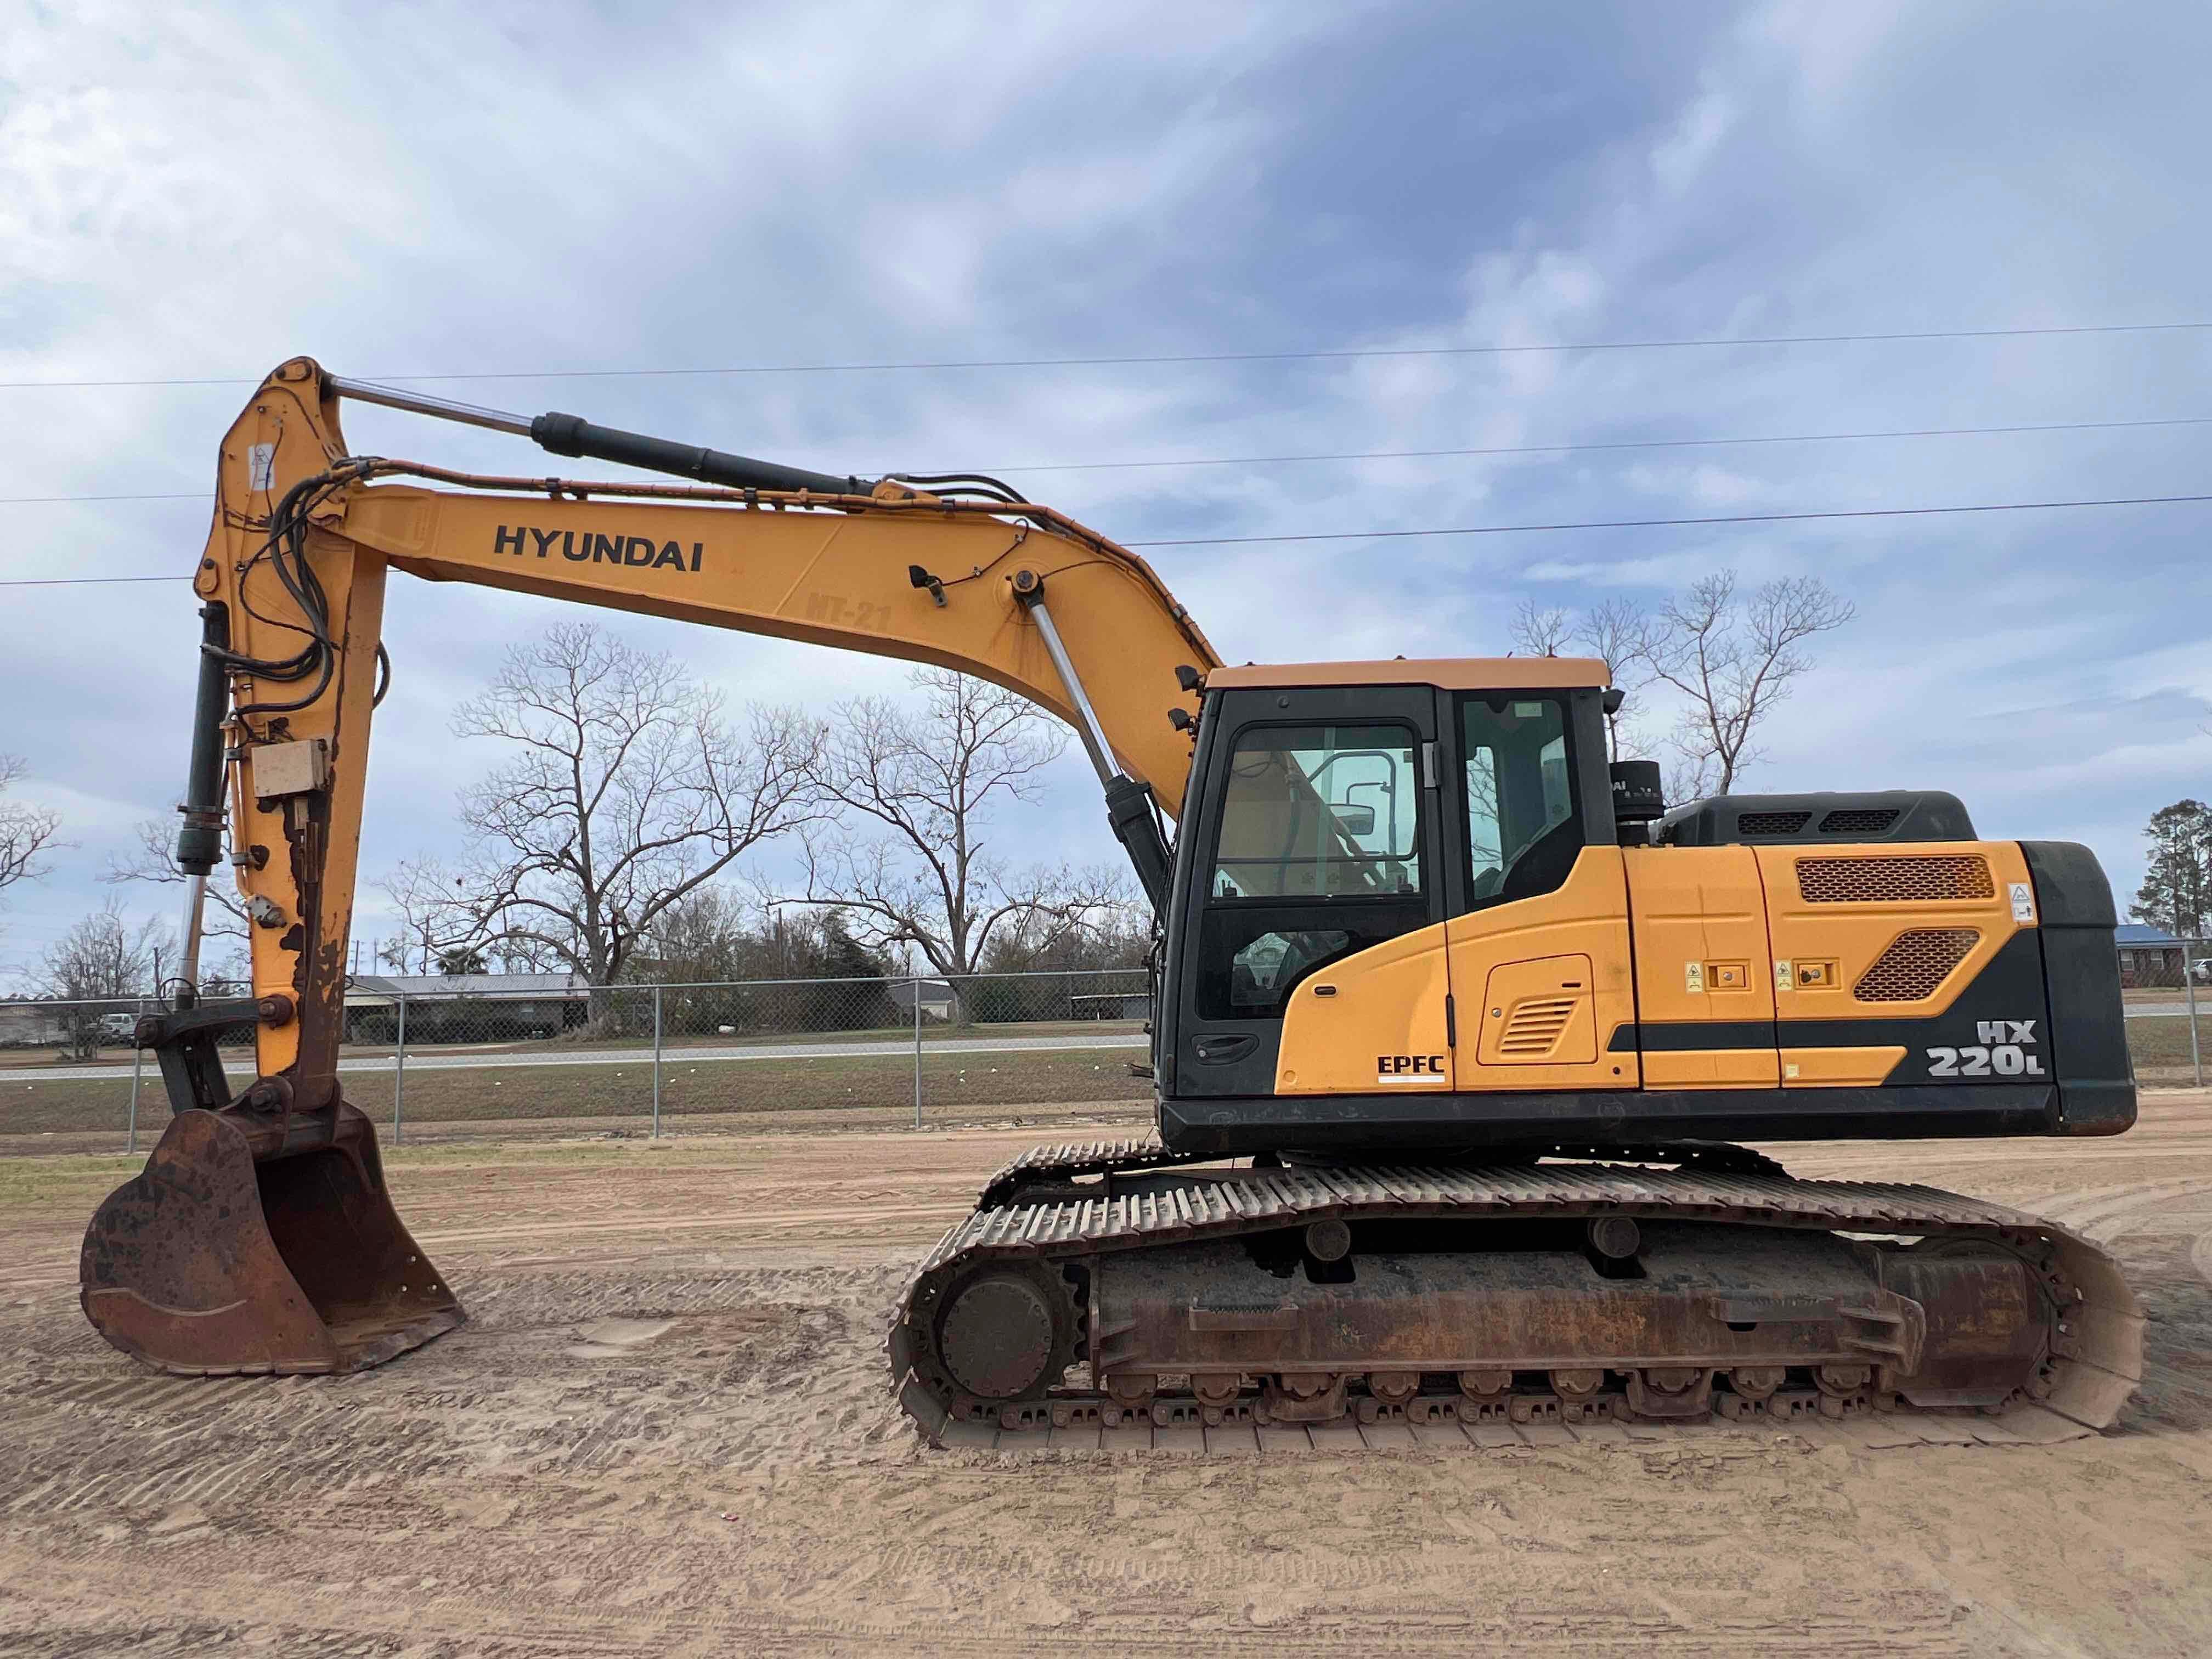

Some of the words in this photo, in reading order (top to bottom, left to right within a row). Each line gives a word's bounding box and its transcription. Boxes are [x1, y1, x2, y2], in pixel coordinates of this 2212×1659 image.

[494, 525, 703, 572] HYUNDAI
[1977, 1020, 2037, 1043] HX
[1378, 1056, 1445, 1074] EPFC
[1926, 1045, 2045, 1076] 220L
